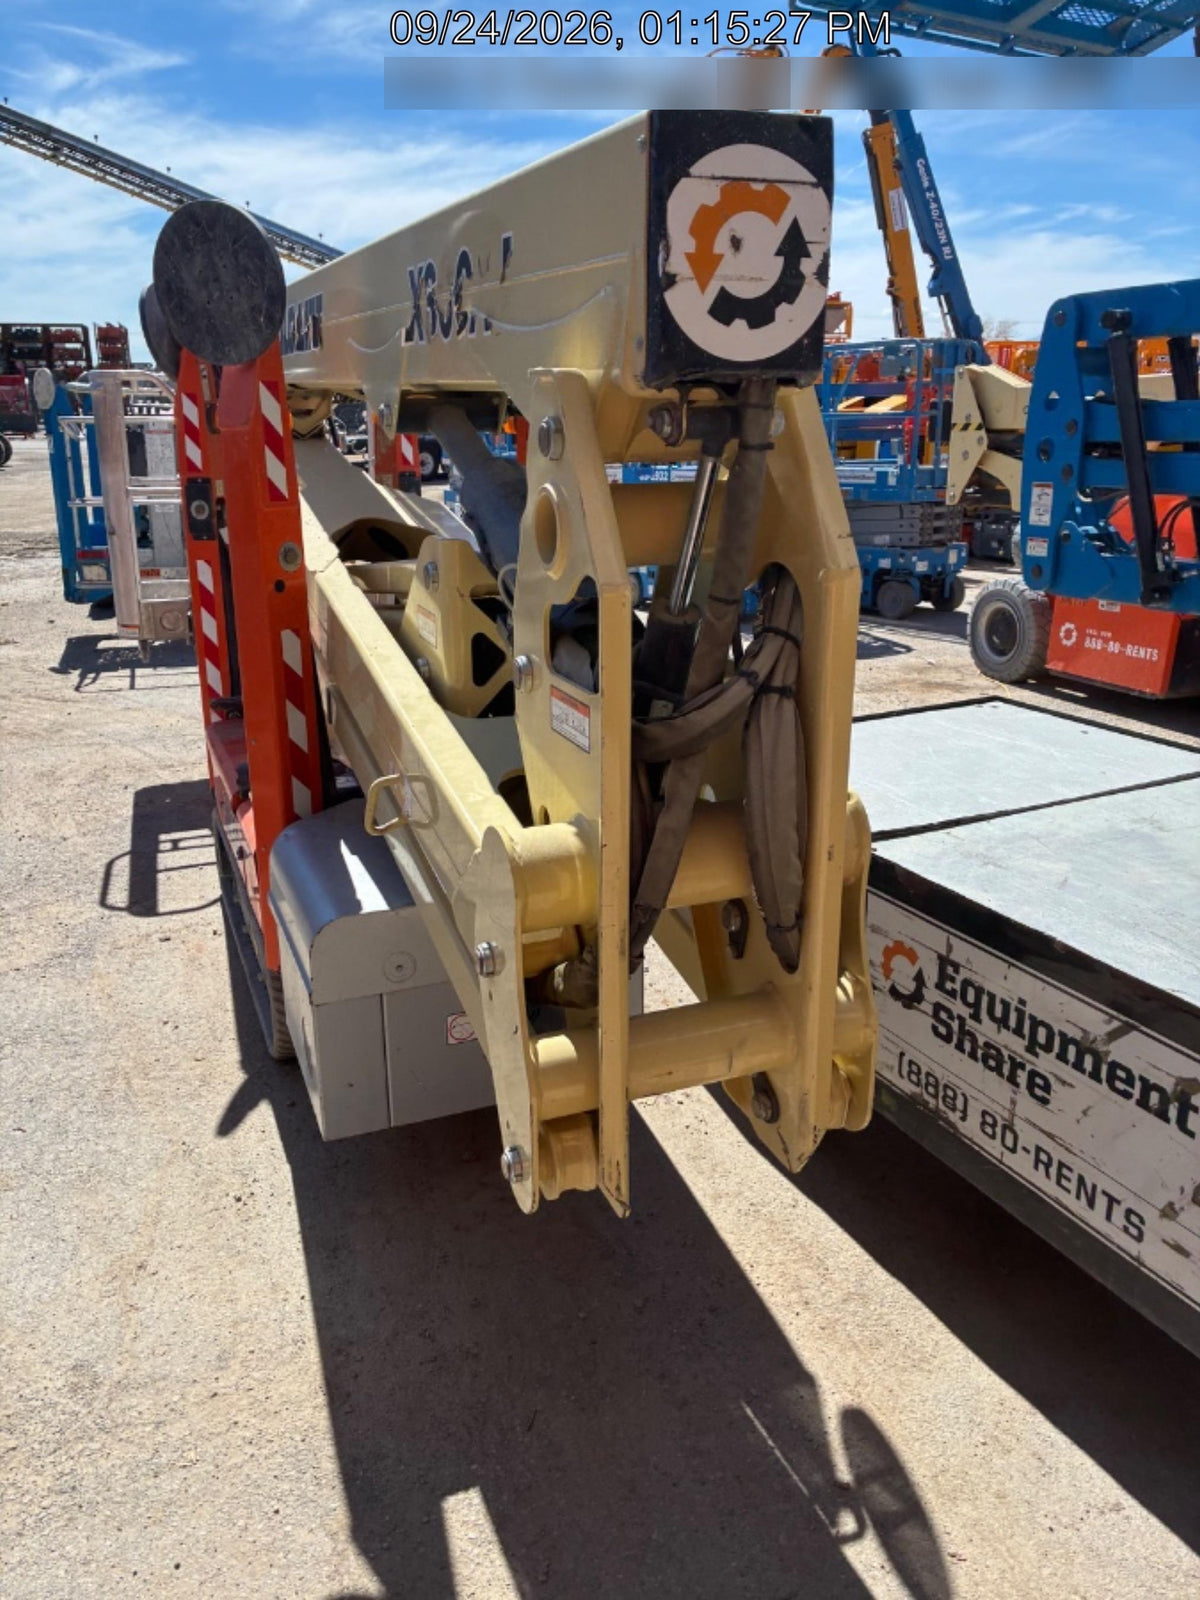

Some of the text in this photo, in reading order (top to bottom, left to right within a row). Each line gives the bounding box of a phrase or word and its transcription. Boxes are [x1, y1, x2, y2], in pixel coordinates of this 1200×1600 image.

[931, 1001, 1052, 1106] Share
[934, 954, 1200, 1139] Equipment
[897, 1051, 1146, 1243] (888) 80-RENTS
